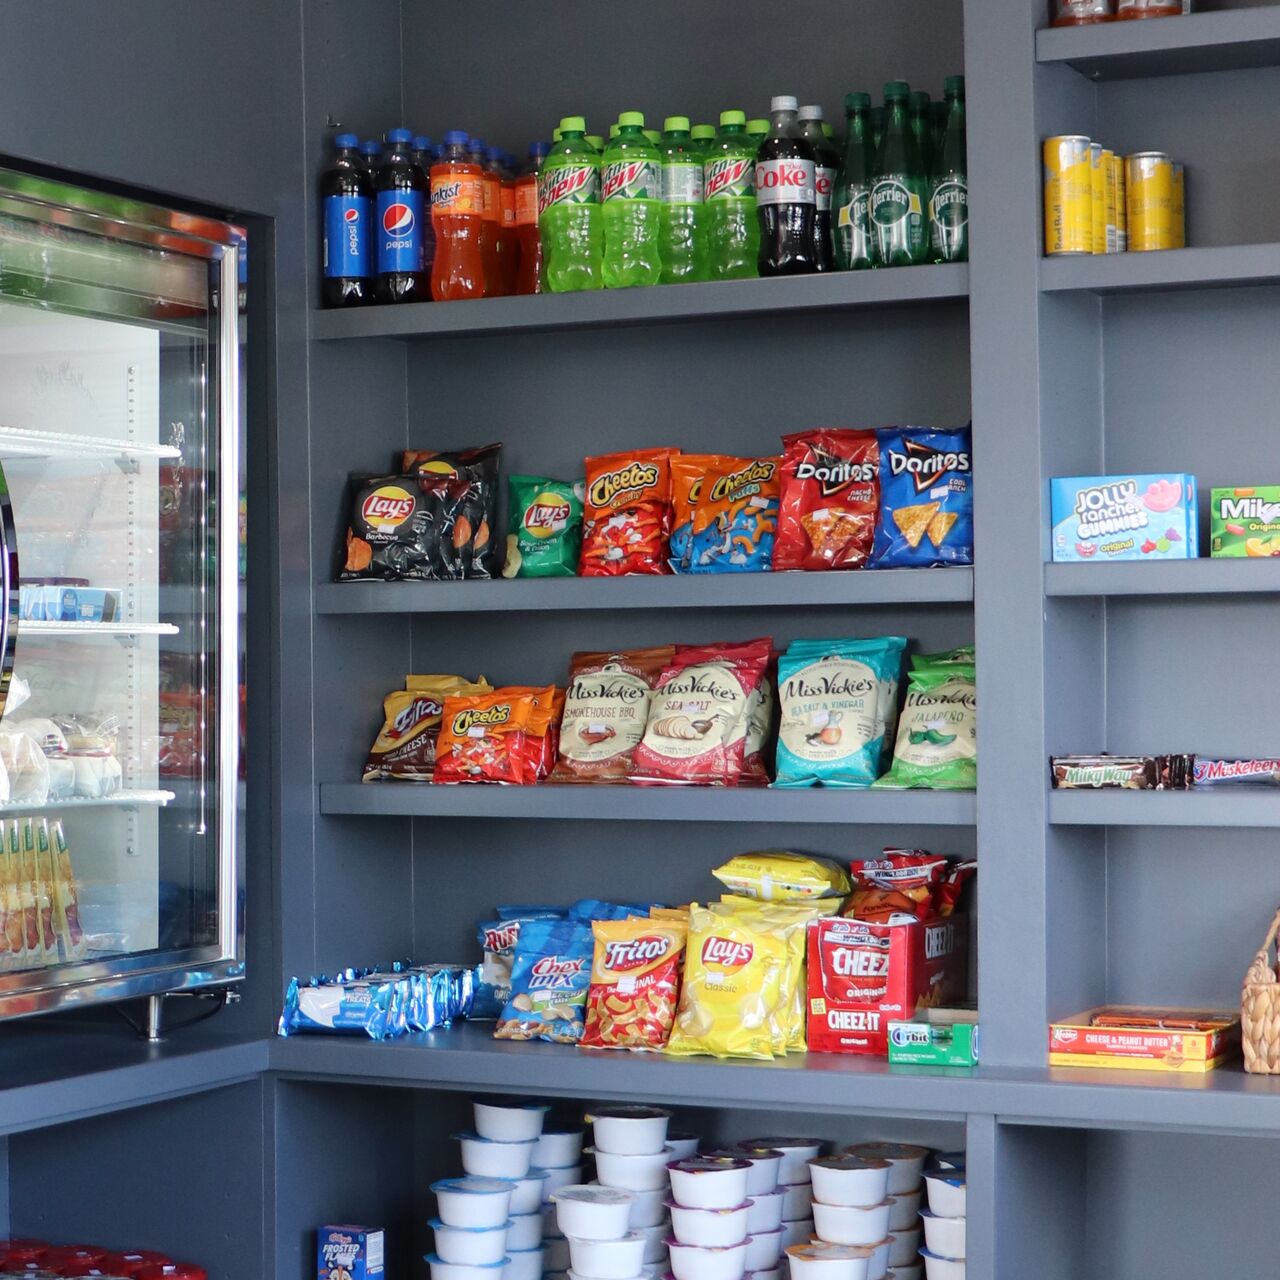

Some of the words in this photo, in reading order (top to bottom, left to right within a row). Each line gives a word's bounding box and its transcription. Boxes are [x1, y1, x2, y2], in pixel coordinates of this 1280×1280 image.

[756, 164, 807, 190] Coke
[386, 239, 413, 251] pepsi
[796, 463, 874, 483] Doritos
[888, 448, 970, 476] Doritos
[591, 464, 658, 506] Cheetos
[664, 700, 683, 711] SEA
[453, 706, 510, 734] Cheetos
[605, 937, 669, 969] Fritos
[532, 954, 586, 976] Chex
[704, 982, 738, 993] Classic
[323, 1244, 360, 1254] FROSTED
